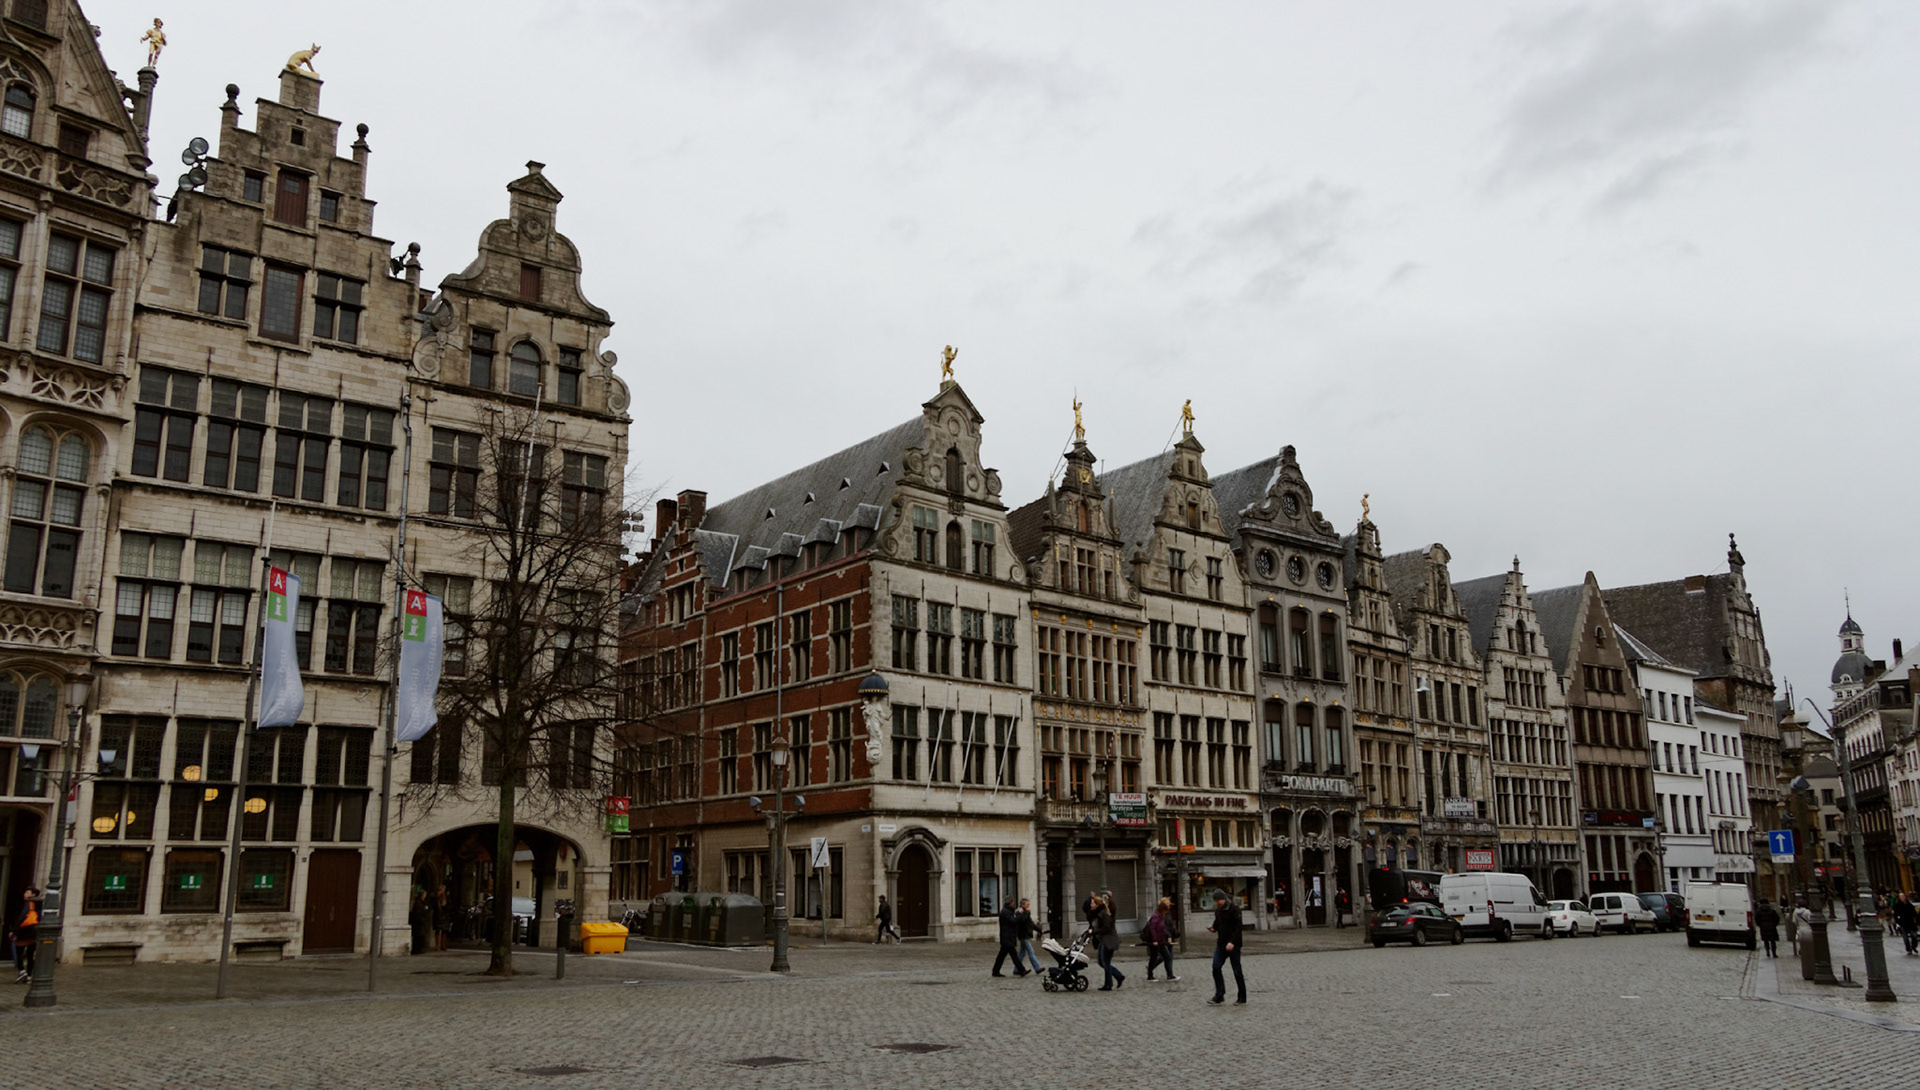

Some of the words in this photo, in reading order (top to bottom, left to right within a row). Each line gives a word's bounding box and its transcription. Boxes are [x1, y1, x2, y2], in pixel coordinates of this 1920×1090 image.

[273, 573, 283, 589] A
[410, 595, 422, 610] A
[1282, 775, 1348, 793] BONAPARTE
[616, 800, 624, 810] A
[1165, 795, 1211, 807] PARFUMS
[1214, 797, 1224, 807] IN
[1226, 797, 1247, 808] FINE
[673, 854, 682, 868] P
